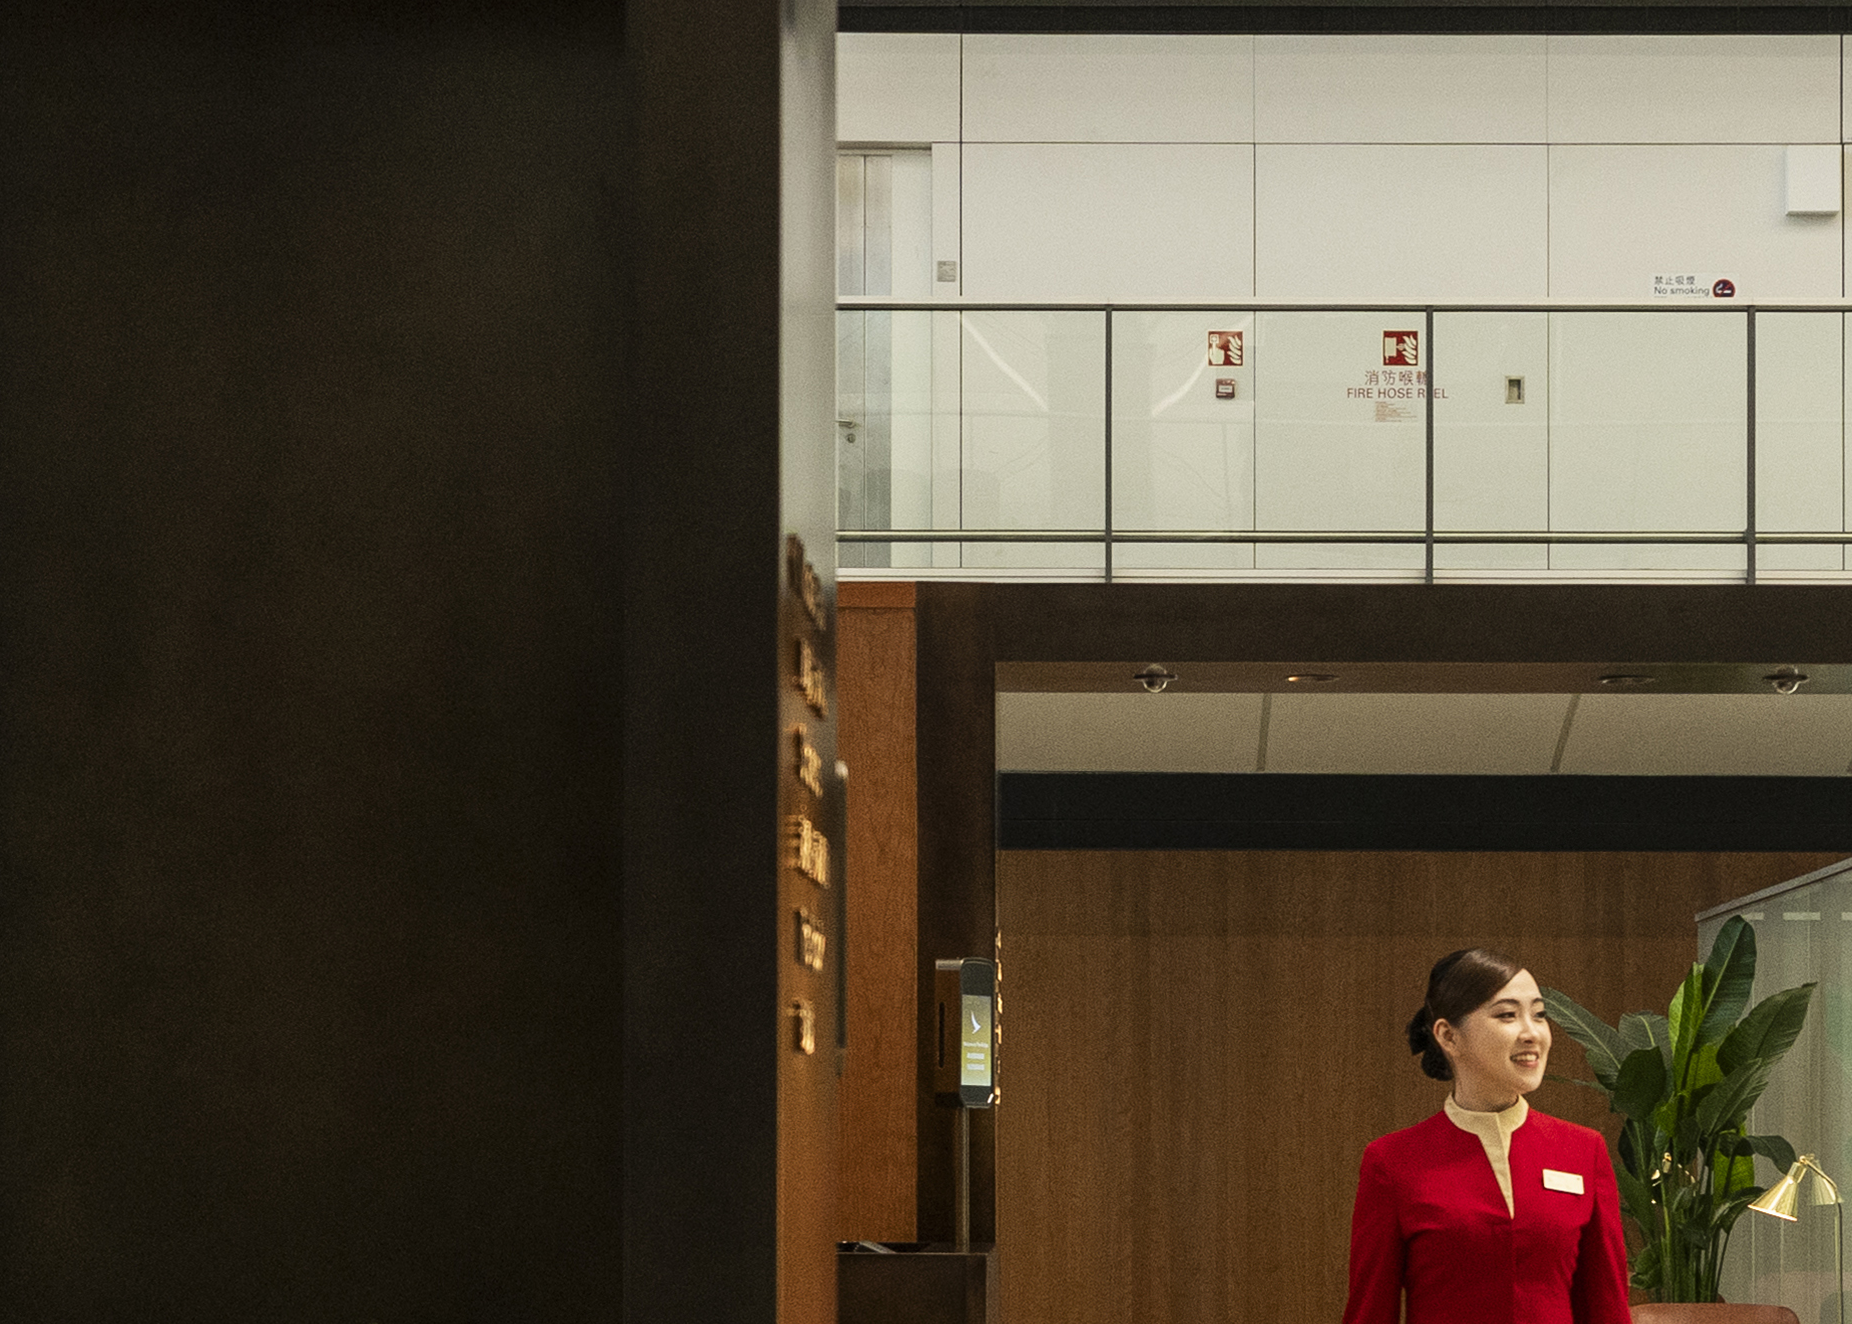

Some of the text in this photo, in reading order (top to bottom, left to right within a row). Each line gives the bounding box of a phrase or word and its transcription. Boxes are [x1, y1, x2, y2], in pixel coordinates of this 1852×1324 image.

[1654, 286, 1710, 297] No smoking
[1347, 388, 1449, 399] FIRE HOSE REL
